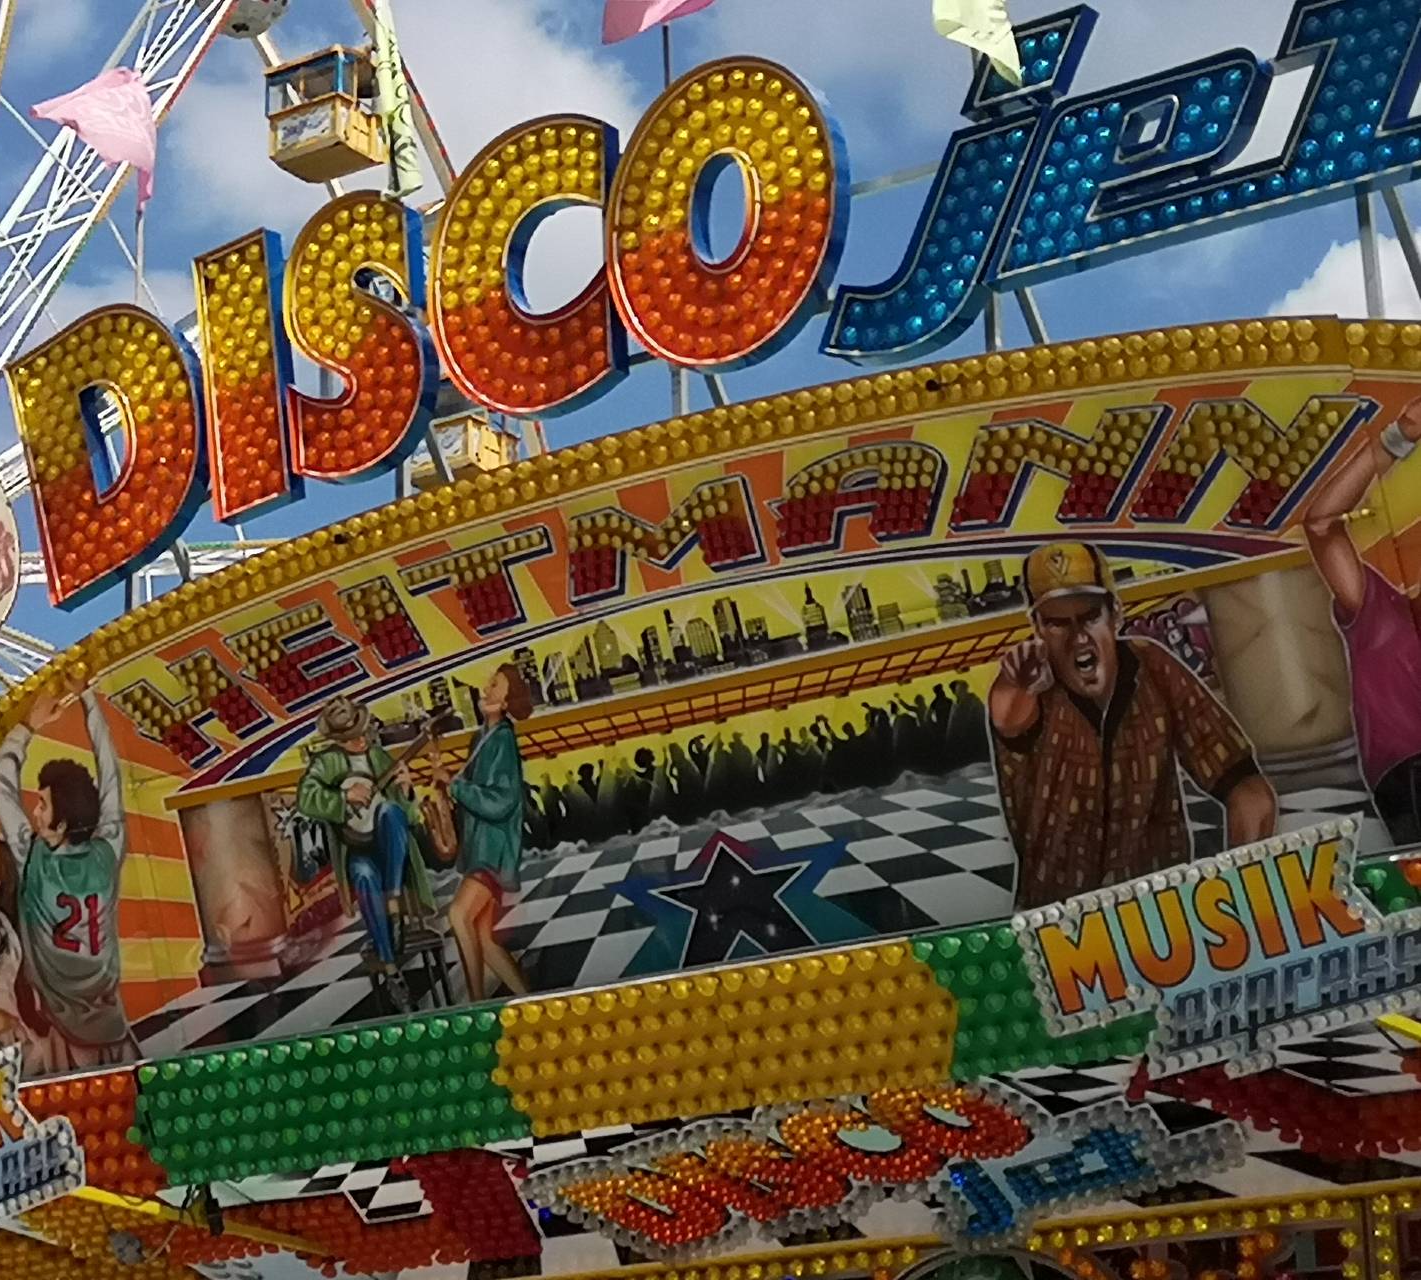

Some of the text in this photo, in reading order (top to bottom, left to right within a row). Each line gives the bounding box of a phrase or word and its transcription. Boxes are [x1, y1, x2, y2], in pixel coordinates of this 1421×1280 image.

[6, 57, 850, 610] DISCO
[108, 395, 1380, 770] HEITMANN
[52, 892, 99, 956] 21
[1035, 838, 1367, 1016] MUSIK
